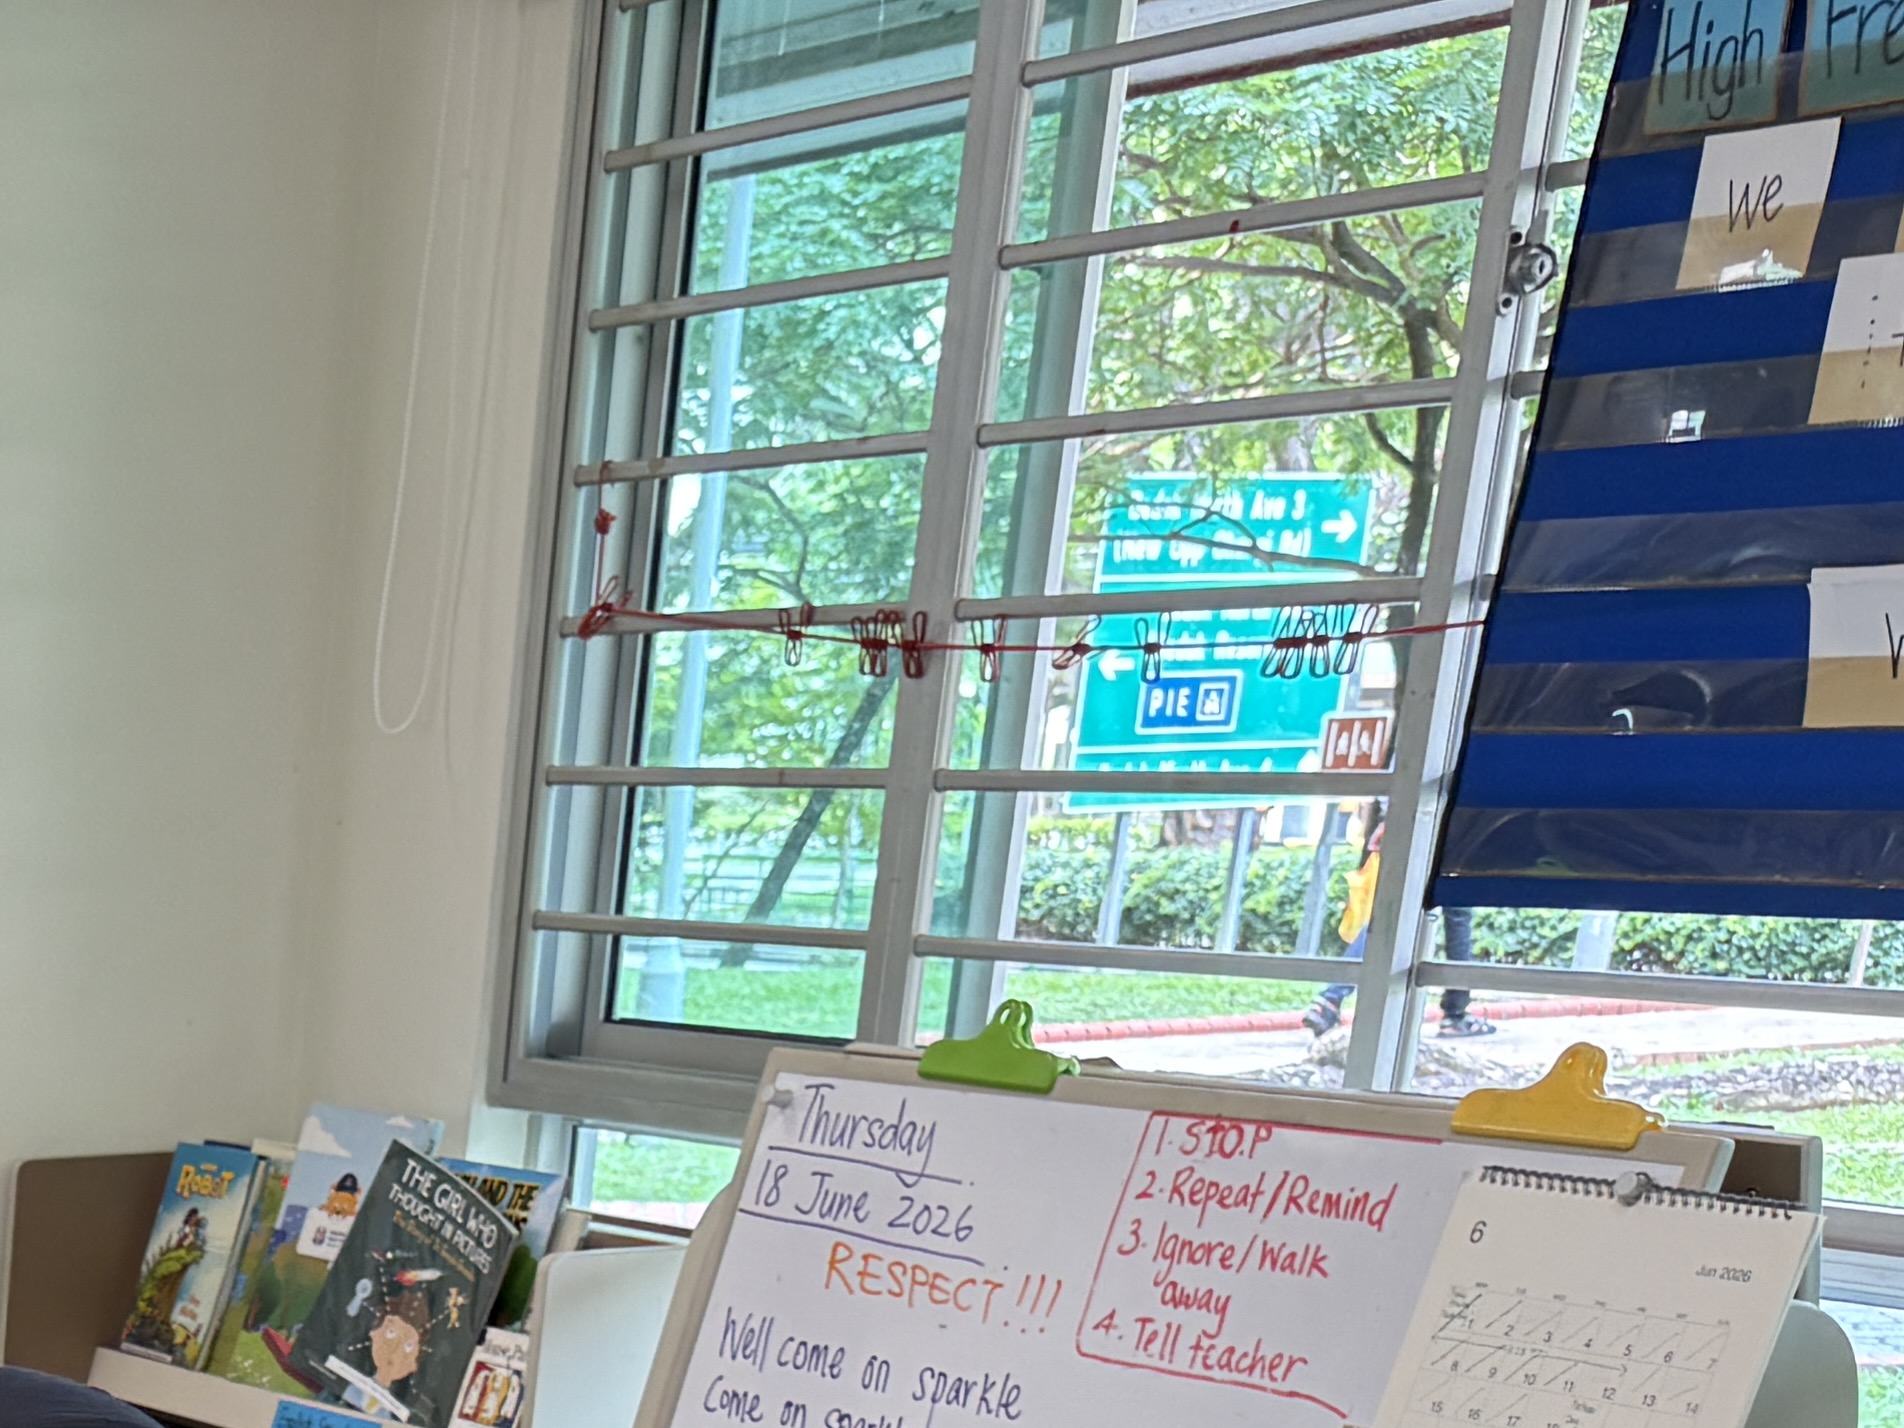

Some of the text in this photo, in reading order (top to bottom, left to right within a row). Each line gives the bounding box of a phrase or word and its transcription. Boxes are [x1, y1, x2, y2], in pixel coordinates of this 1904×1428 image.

[1659, 0, 1763, 121] High
[1148, 686, 1190, 717] PIE
[798, 1083, 936, 1188] Thursday
[388, 1183, 492, 1274] THOUGHT IN PICTURES
[401, 1158, 498, 1249] THE GIRL WHO
[753, 1158, 974, 1243] 18 June 2026
[1134, 1165, 1399, 1233] 2. Repeat/Remind
[1469, 1220, 1487, 1244] 6
[1116, 1218, 1330, 1288] 3. Ignore/Walk
[1719, 1268, 1752, 1283] 2026
[1092, 1308, 1309, 1383] 4. Tell teacher
[1160, 1279, 1232, 1340] away
[718, 1306, 775, 1373] Well
[776, 1336, 846, 1380] come
[861, 1355, 890, 1394] on
[703, 1374, 763, 1423] Come
